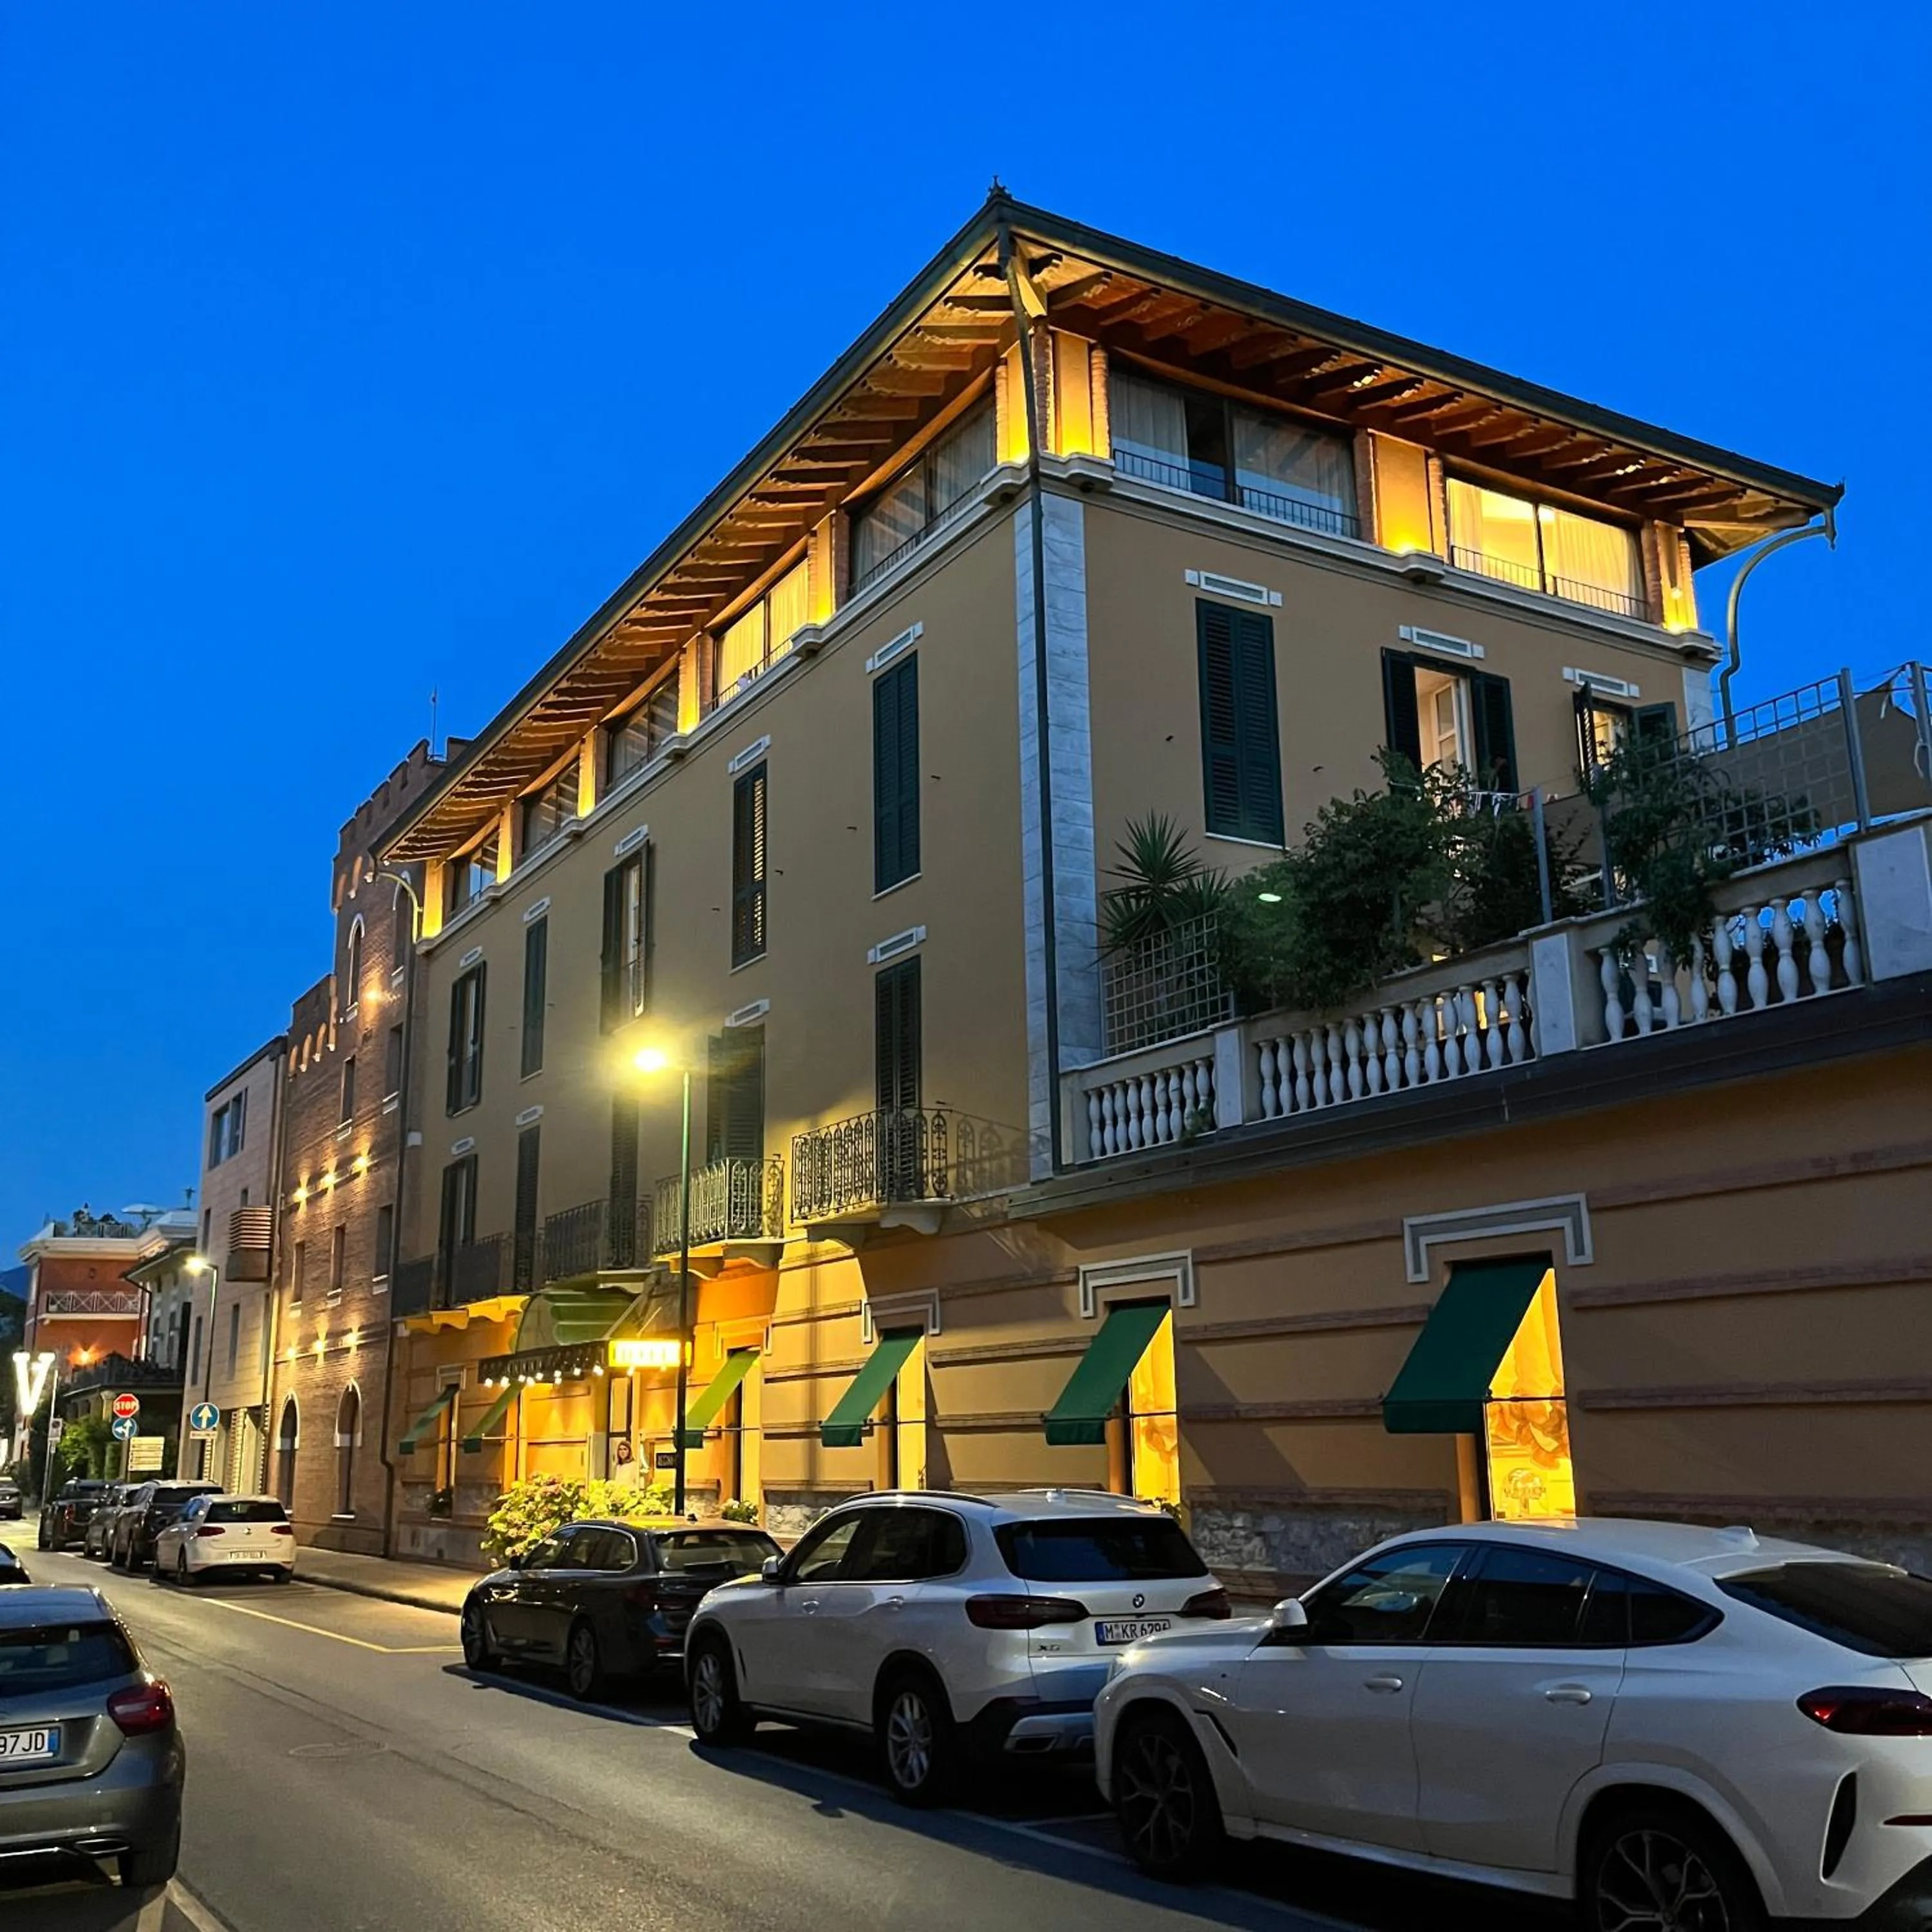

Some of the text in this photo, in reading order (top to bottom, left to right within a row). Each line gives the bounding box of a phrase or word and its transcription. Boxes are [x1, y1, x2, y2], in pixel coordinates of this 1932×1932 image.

[115, 1400, 137, 1411] STOP
[1104, 1624, 1113, 1638] M
[1121, 1624, 1137, 1638] KR
